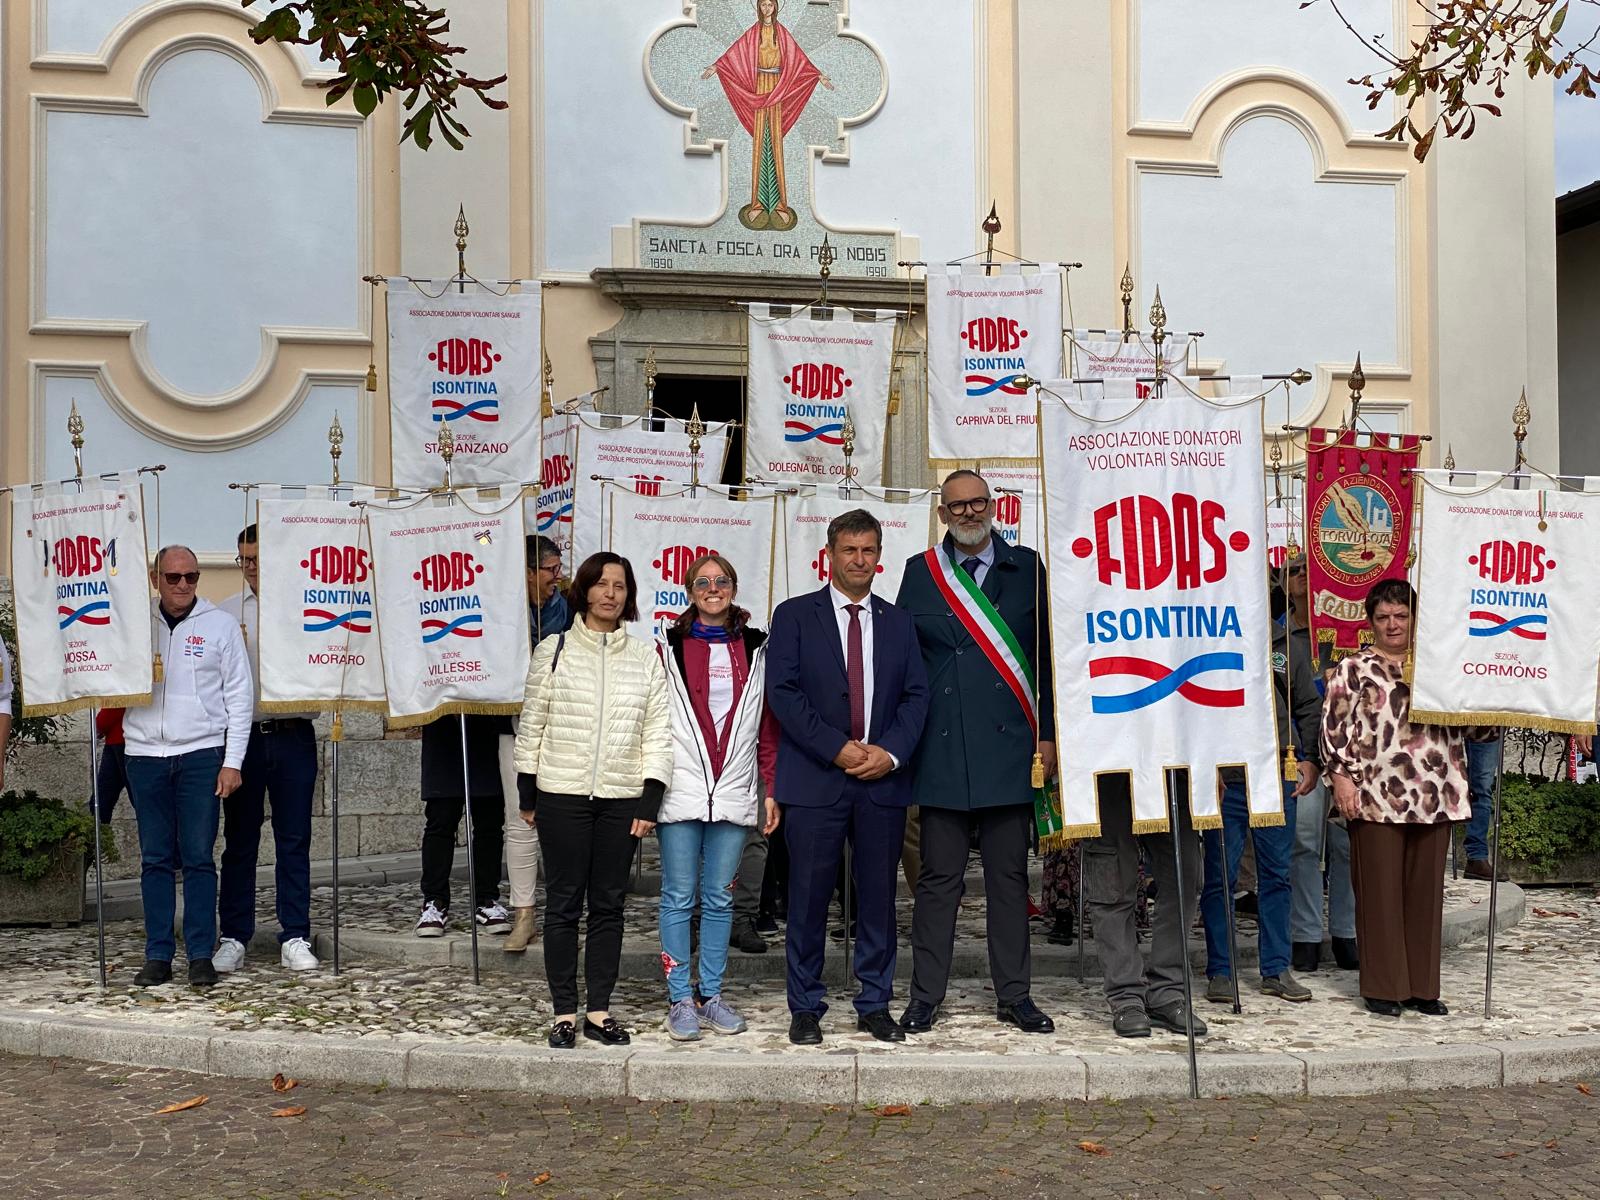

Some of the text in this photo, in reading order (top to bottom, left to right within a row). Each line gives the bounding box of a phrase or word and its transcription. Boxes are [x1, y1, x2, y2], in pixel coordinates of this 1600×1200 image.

[650, 238, 886, 262] SANCTA FOSCA ORA PO NOBIS
[650, 258, 673, 269] 1890
[865, 266, 887, 277] 1990
[968, 316, 1020, 352] FIDAS
[437, 338, 492, 376] FIDAS
[964, 357, 1026, 370] ISONTINA
[432, 381, 498, 395] ISONTINA
[791, 363, 845, 400] FIDAS
[785, 403, 846, 419] ISONTINA
[956, 415, 1039, 426] CAPRIVA DEL FRIU
[1068, 430, 1242, 451] ASSOCIAZIONE DONATORI
[769, 462, 859, 477] DOLEGNA DEL COLIO
[1087, 452, 1226, 471] VOLONTARI SANGUE
[1343, 477, 1389, 496] AZIENDALI
[536, 487, 574, 509] SONTINA
[996, 495, 1021, 525] FID
[1312, 494, 1332, 544] DONATORI
[1448, 505, 1584, 520] ASSOCIAZIONE DONATORI VOLOTARI SANGUE
[281, 516, 319, 524] ASSOCIAZIONE
[319, 517, 347, 525] DONATORI
[390, 518, 501, 537] ASSOCIAZIONE DONATORI VOLONTARI SANGUE
[634, 513, 751, 527] ASSOCIAZIONE DONATORI VOLONTARI SANGUE
[1093, 492, 1228, 590] FIDAS
[54, 535, 103, 577] FIDAS
[310, 545, 368, 585] FIDAS
[661, 545, 720, 586] FID
[1313, 545, 1351, 583] AUTONOMO
[1478, 540, 1547, 585] FIDAS
[421, 551, 475, 592] FIDAS
[304, 589, 371, 605] ISONTINA
[419, 594, 481, 615] ISONTINA
[655, 590, 689, 606] ISON
[1470, 588, 1548, 609] ISONTINA
[1086, 606, 1243, 644] ISONTINA
[308, 653, 365, 666] MORARO
[1494, 653, 1519, 661] SEZIONE
[428, 660, 482, 676] VILLESSE
[1463, 661, 1548, 679] CORMÒNS
